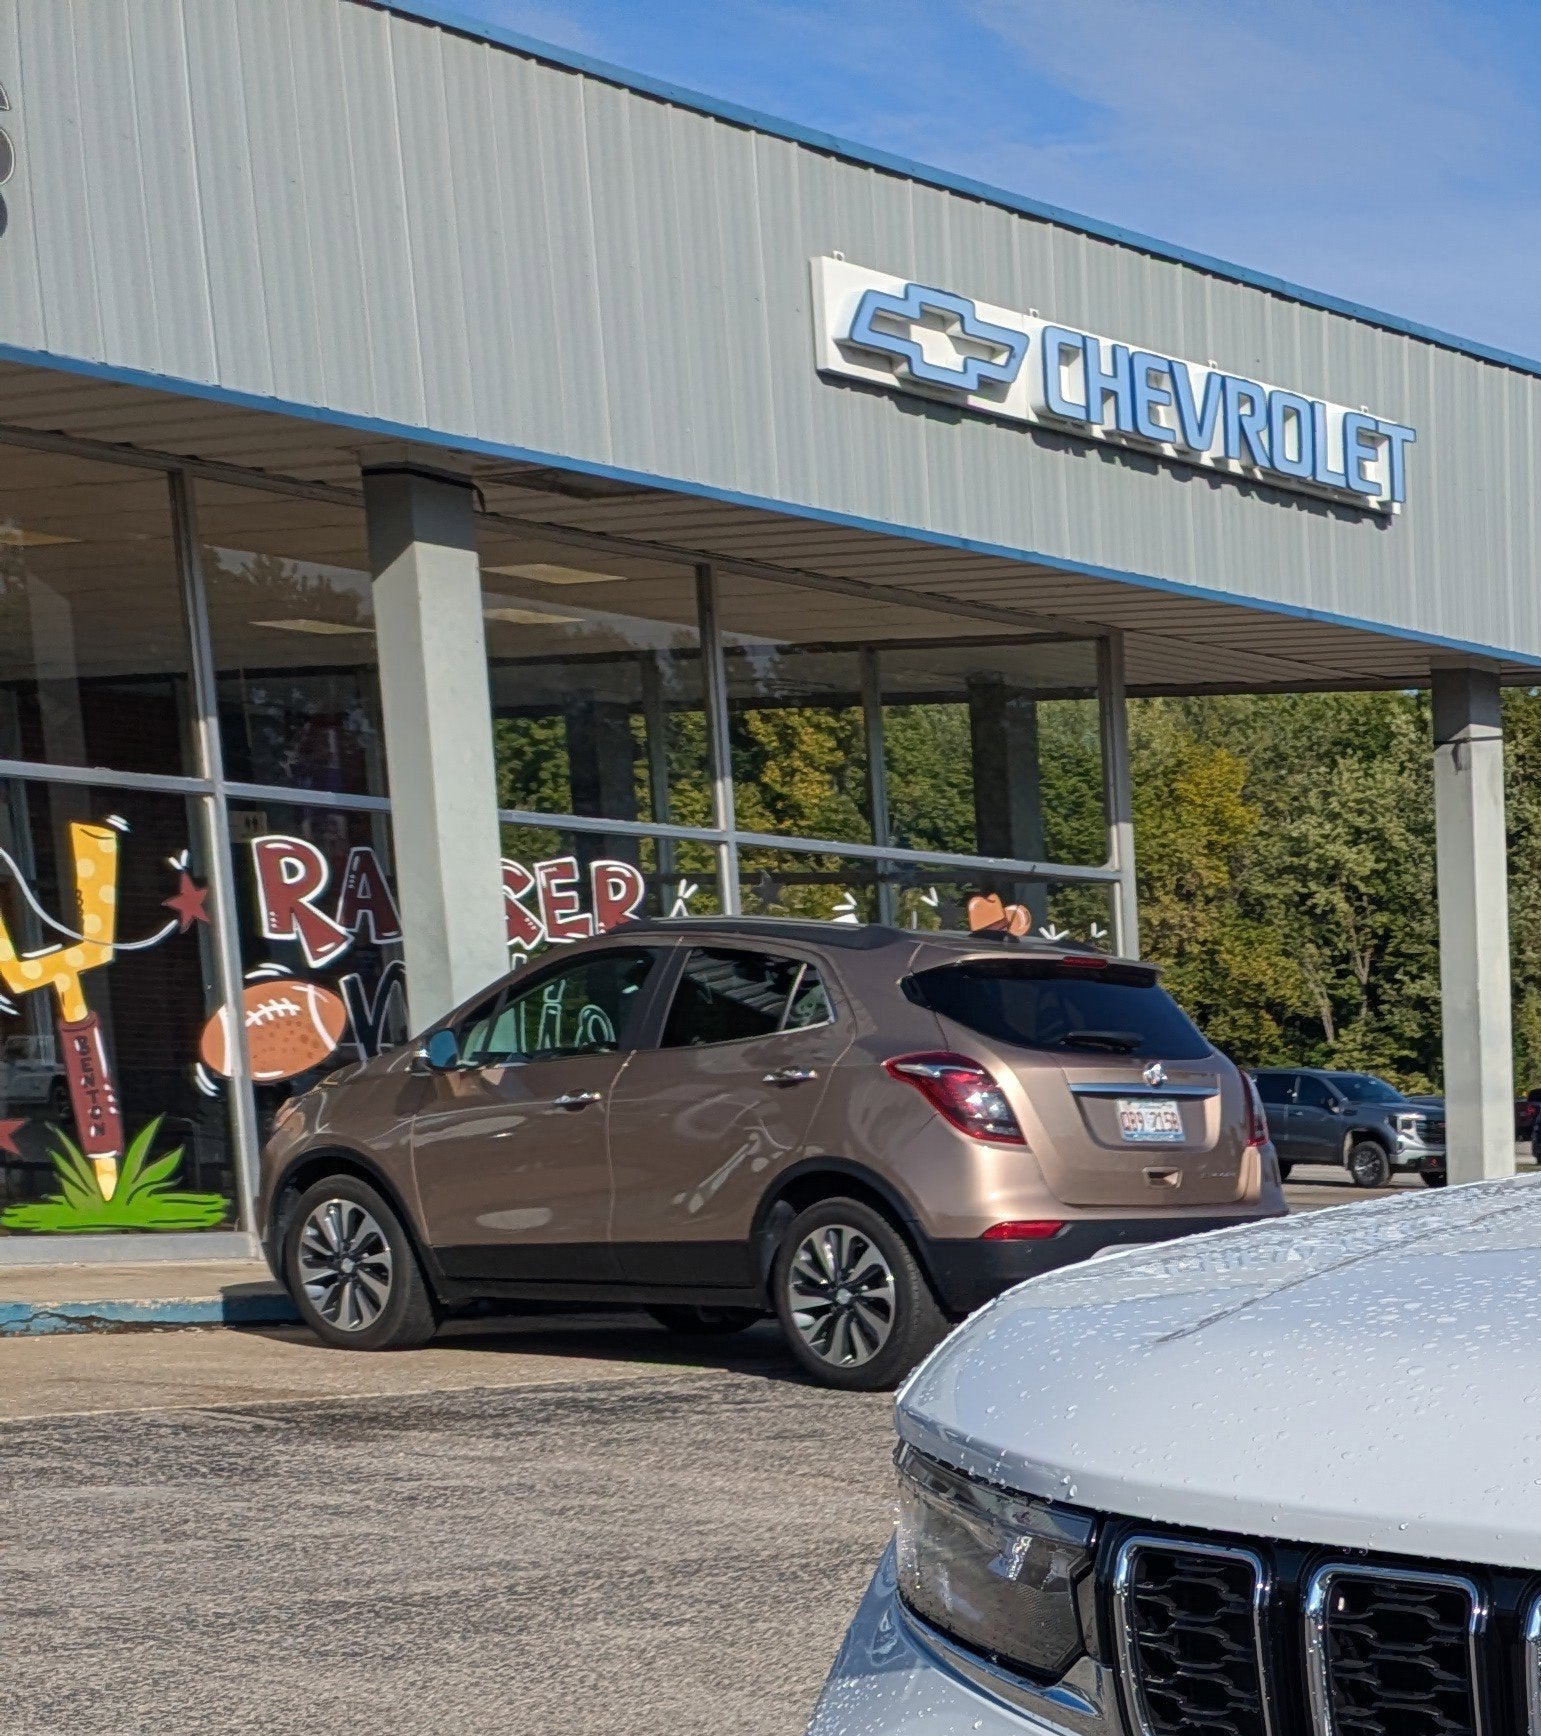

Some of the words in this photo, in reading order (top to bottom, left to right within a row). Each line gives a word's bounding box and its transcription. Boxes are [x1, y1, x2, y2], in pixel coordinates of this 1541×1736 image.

[1041, 325, 1417, 503] CHEVROLET
[251, 835, 645, 968] RAER
[75, 1035, 105, 1137] BENTON
